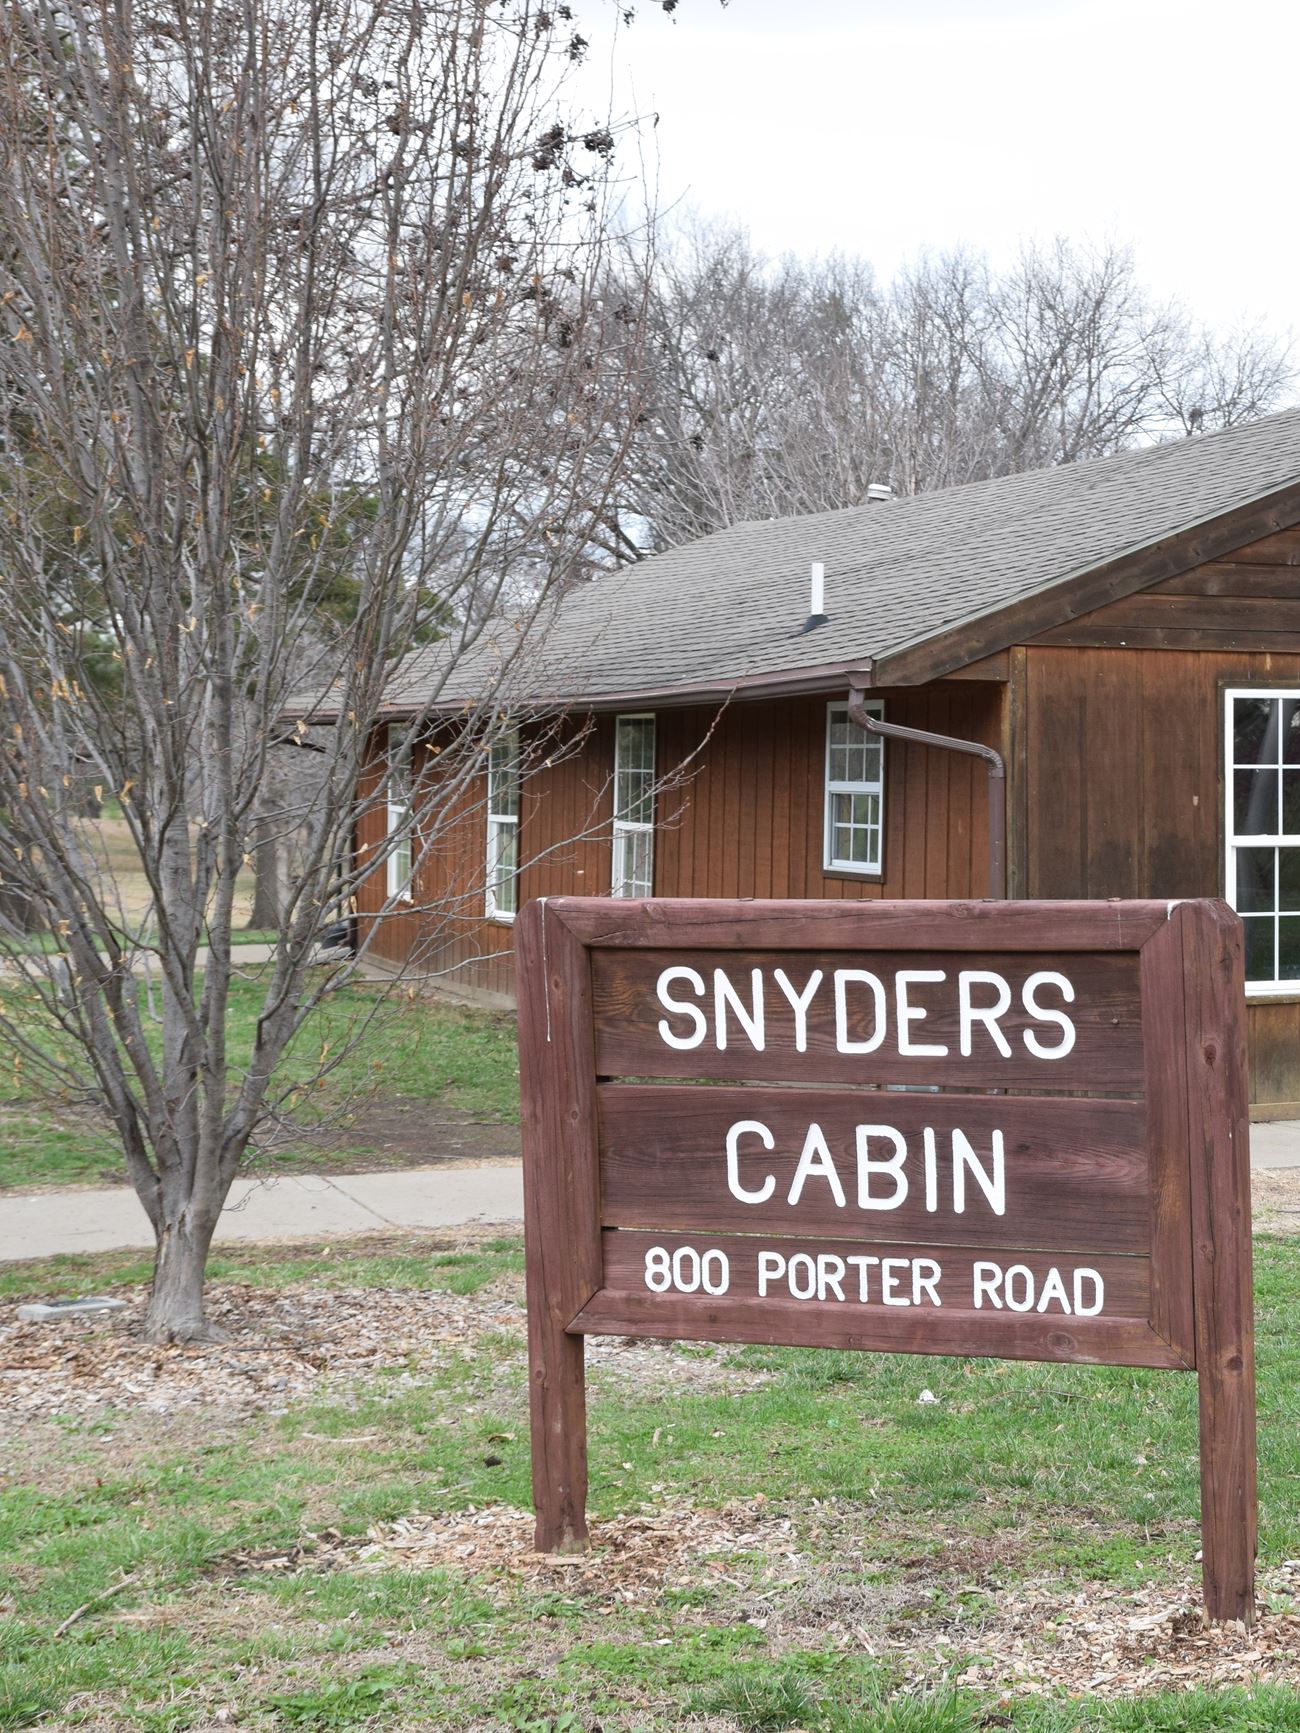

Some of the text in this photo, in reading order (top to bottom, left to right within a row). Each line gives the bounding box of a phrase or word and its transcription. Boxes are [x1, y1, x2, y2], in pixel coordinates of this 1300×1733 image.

[656, 965, 1076, 1060] SNYDERS
[725, 1120, 1006, 1216] CABIN
[644, 1245, 1105, 1317] 800 PORTER ROAD
